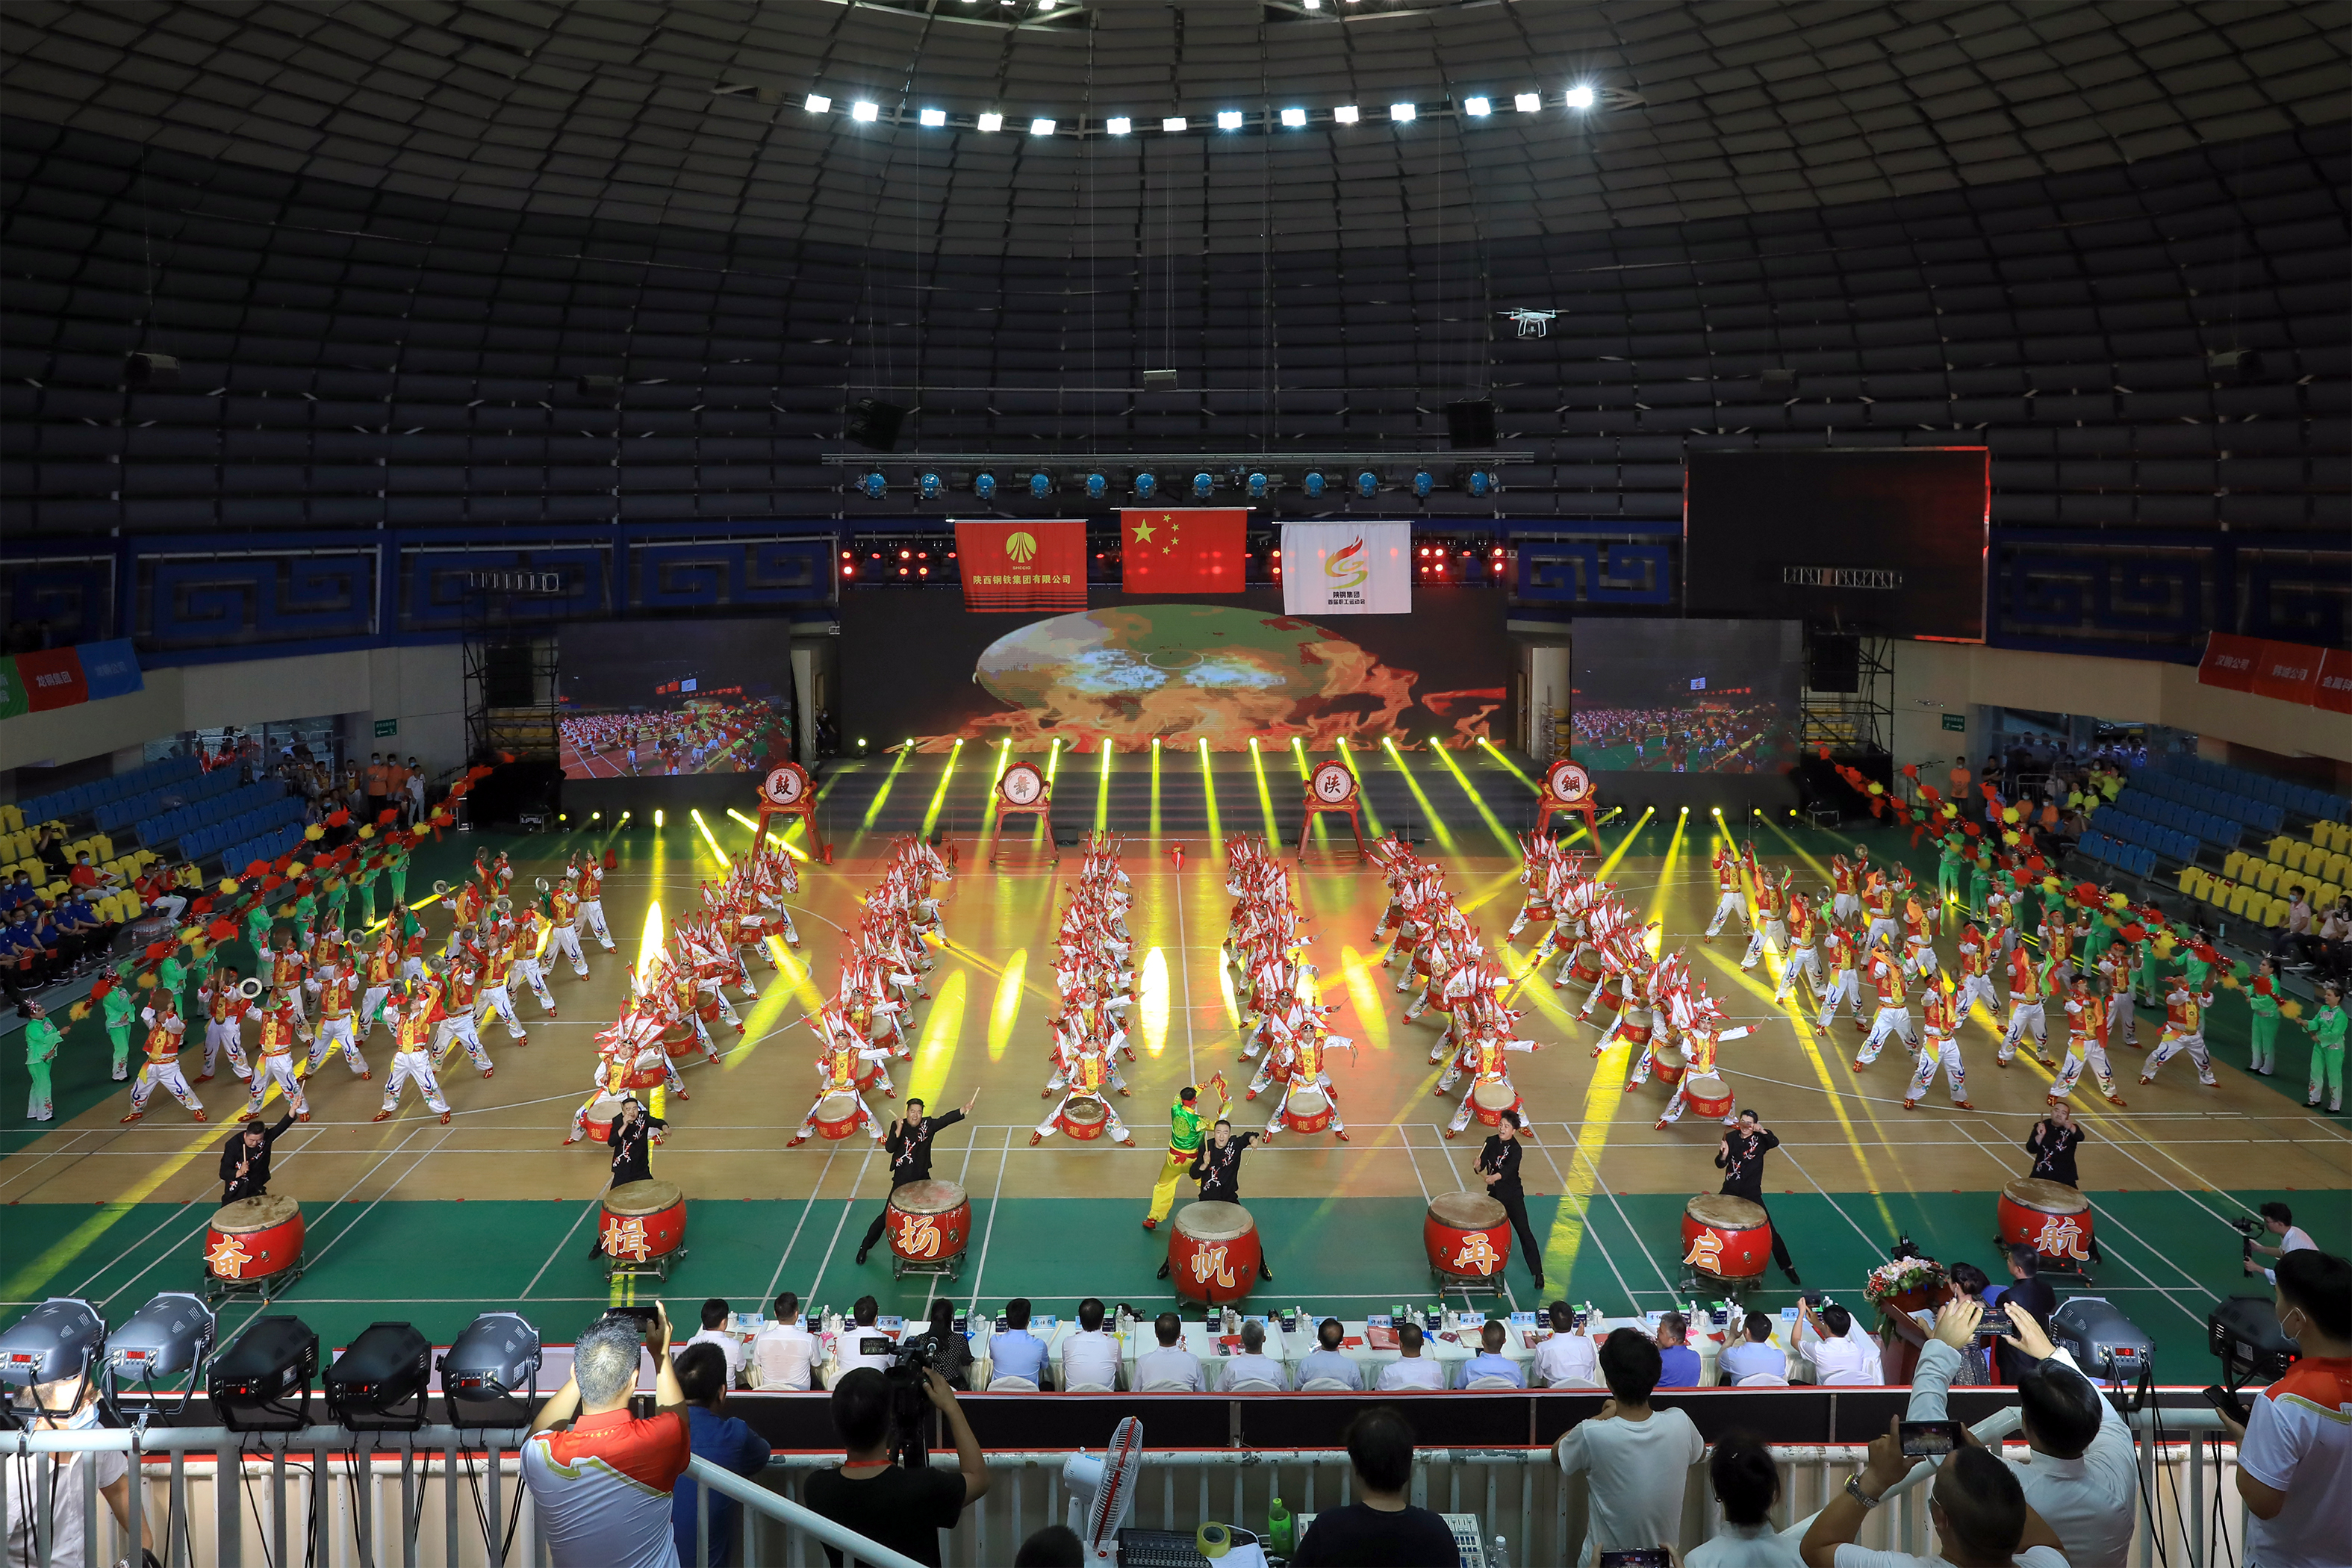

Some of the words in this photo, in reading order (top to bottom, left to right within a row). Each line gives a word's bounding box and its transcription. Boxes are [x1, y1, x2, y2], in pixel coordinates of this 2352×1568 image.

[973, 575, 1071, 585] 陕西钢铁集团有限公司
[36, 671, 72, 688] 龙钢集团
[774, 774, 793, 795] 鼓
[1325, 774, 1341, 794] 陕
[204, 1233, 253, 1279] 奋
[601, 1217, 653, 1263] 楫
[897, 1216, 941, 1257] 扬
[1452, 1233, 1501, 1276] 再
[1682, 1228, 1723, 1275] 启
[2033, 1216, 2091, 1262] 航
[1191, 1242, 1236, 1289] 帆
